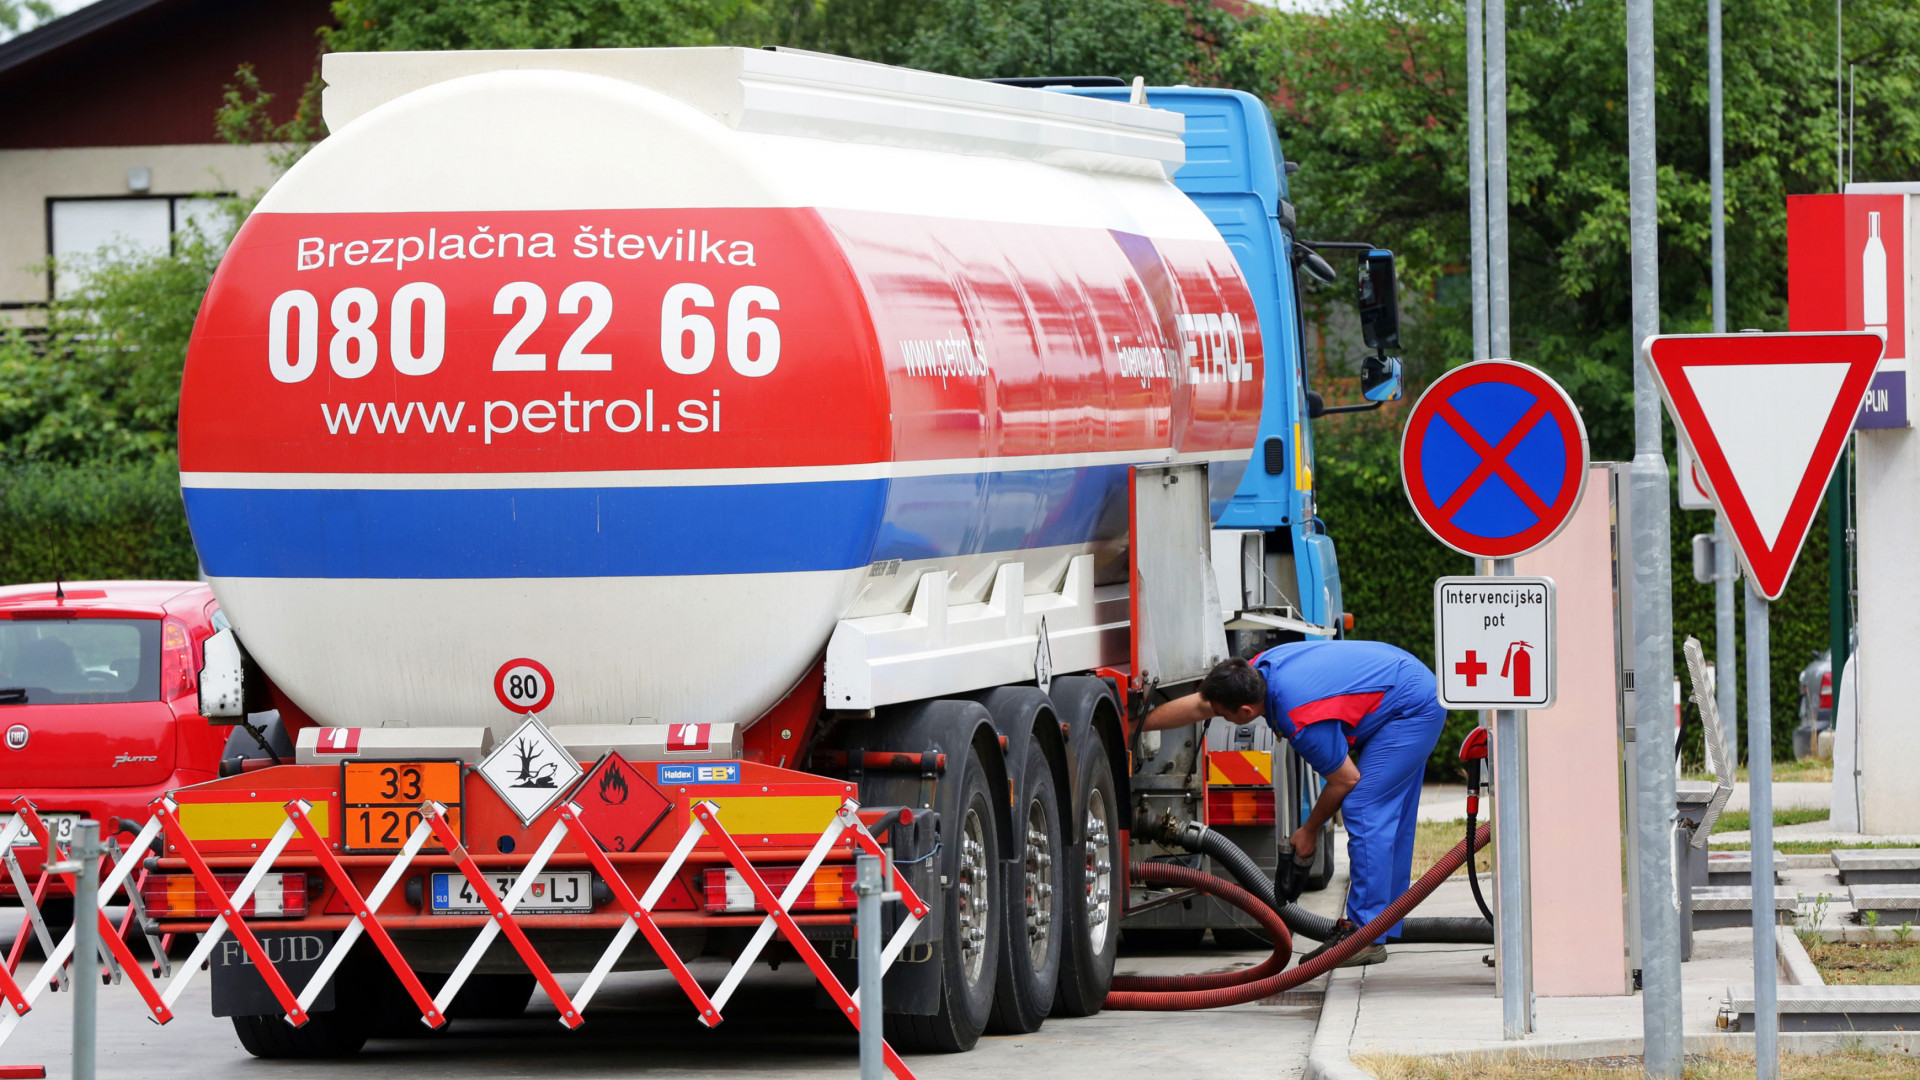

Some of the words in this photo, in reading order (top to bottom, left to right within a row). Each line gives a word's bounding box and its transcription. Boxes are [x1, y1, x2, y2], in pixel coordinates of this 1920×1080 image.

[296, 225, 557, 272] Brezplačna
[572, 224, 757, 268] številka
[268, 281, 446, 384] 080
[491, 280, 614, 372] 22
[660, 282, 781, 378] 66
[899, 327, 990, 391] www.petrol.si
[1865, 389, 1888, 413] PLIN
[320, 388, 721, 445] www.petrol.si
[1446, 589, 1543, 608] Intervencijska
[1484, 613, 1505, 631] pot
[509, 674, 538, 699] 80
[11, 731, 25, 743] FIAT
[380, 767, 421, 800] 33
[664, 770, 692, 779] Haldex
[360, 810, 450, 844] 120
[614, 836, 625, 852] 3
[550, 877, 579, 903] LJ
